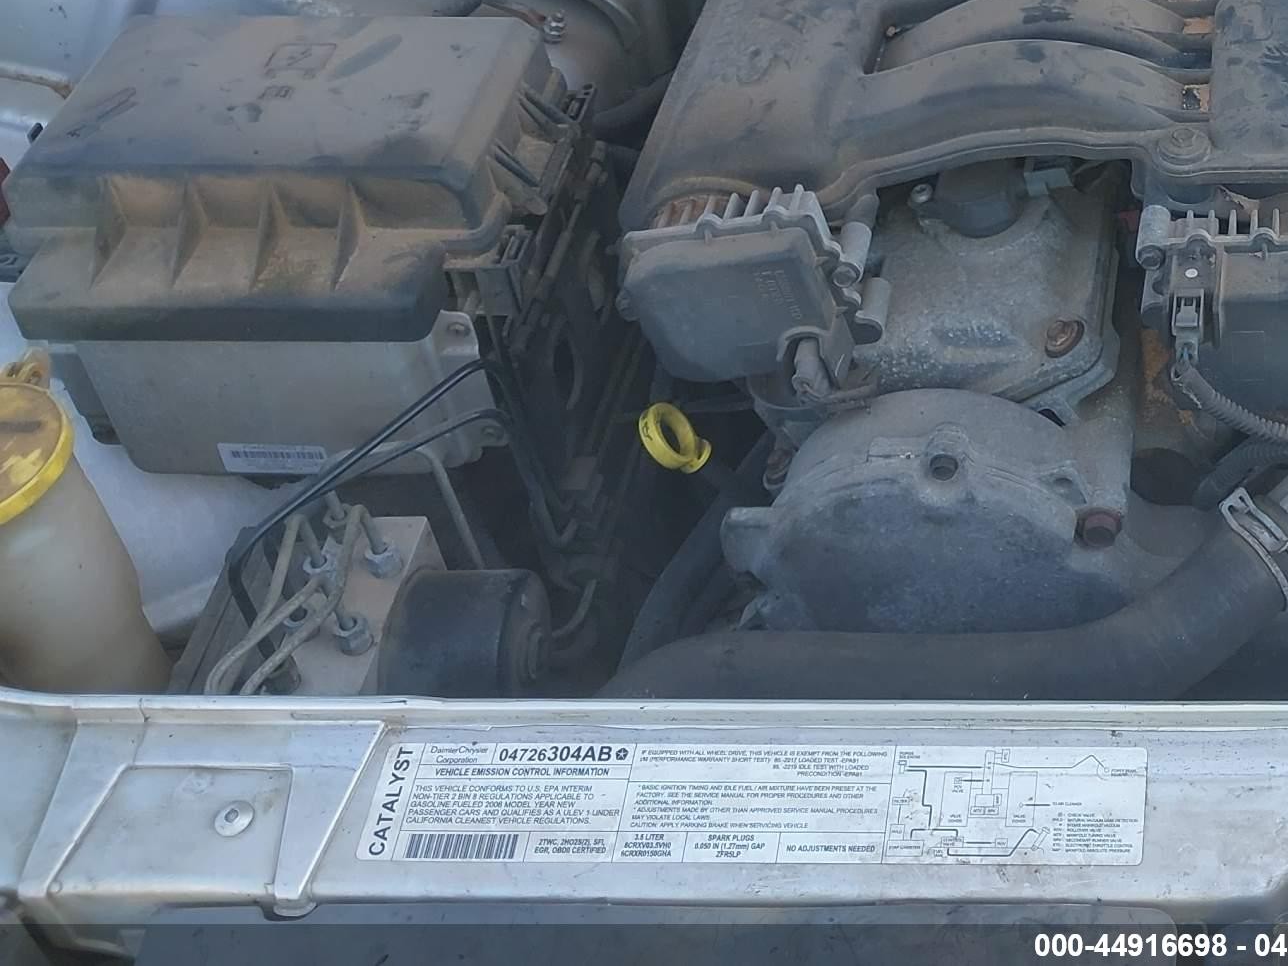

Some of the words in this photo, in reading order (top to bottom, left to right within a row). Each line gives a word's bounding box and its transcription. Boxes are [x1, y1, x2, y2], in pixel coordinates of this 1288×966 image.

[436, 755, 477, 763] Corporation
[499, 746, 612, 761] 04726304AB
[435, 768, 469, 776] VEHICLE
[470, 768, 510, 776] EMISSION
[512, 768, 551, 776] CONTROL
[553, 768, 609, 776] INFORMATION
[369, 747, 414, 855] CATALYST
